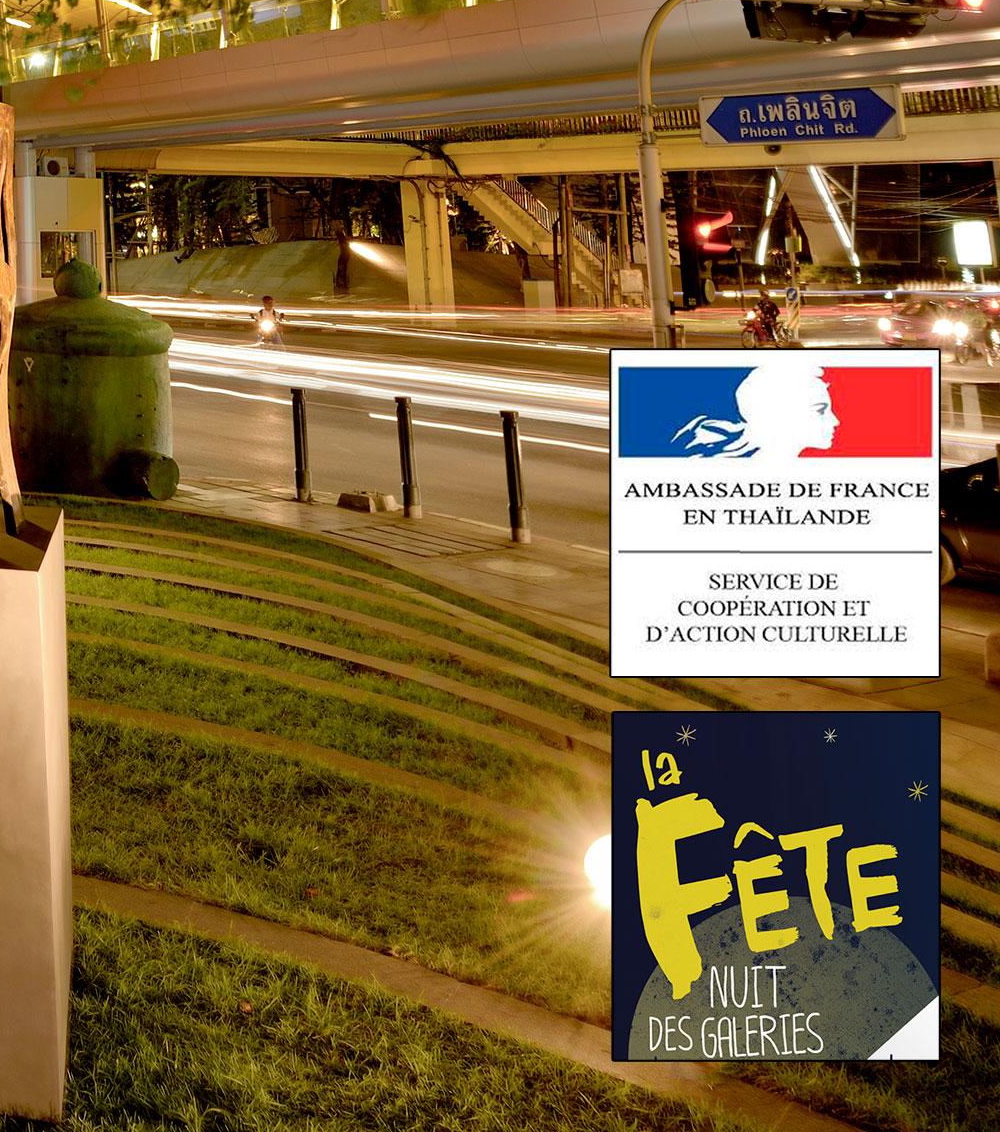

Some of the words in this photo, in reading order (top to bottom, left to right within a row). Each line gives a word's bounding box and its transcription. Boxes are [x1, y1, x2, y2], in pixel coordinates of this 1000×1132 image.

[738, 94, 858, 124] ถ.เพลินจิต
[740, 126, 788, 138] Phloen
[795, 124, 825, 136] Chit
[834, 123, 858, 134] Rd.
